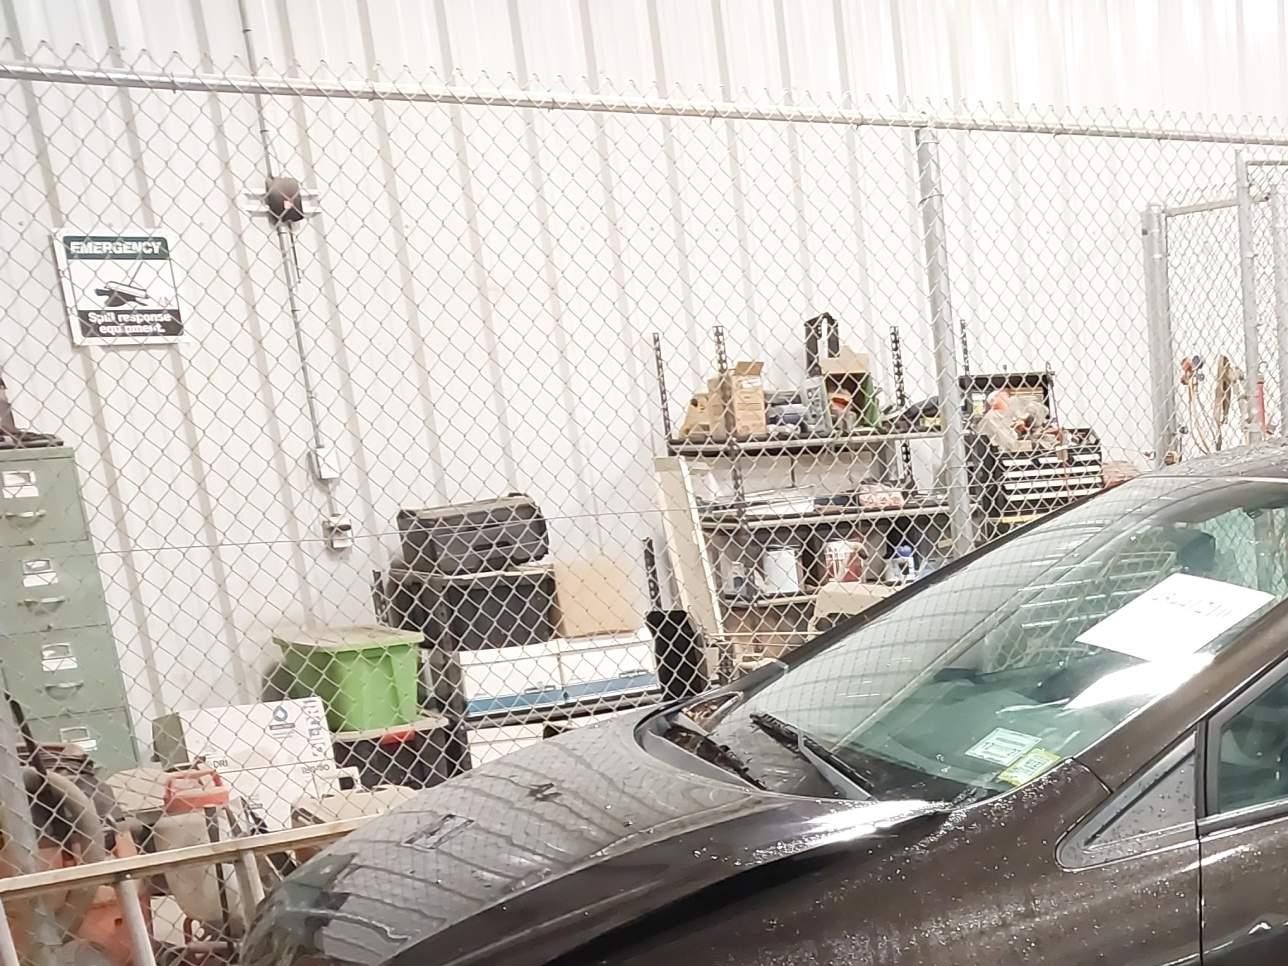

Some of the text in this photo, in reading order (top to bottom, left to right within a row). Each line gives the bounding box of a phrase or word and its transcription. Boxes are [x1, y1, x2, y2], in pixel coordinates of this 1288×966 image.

[70, 241, 161, 255] EMERGENCY
[88, 312, 172, 325] Spill response
